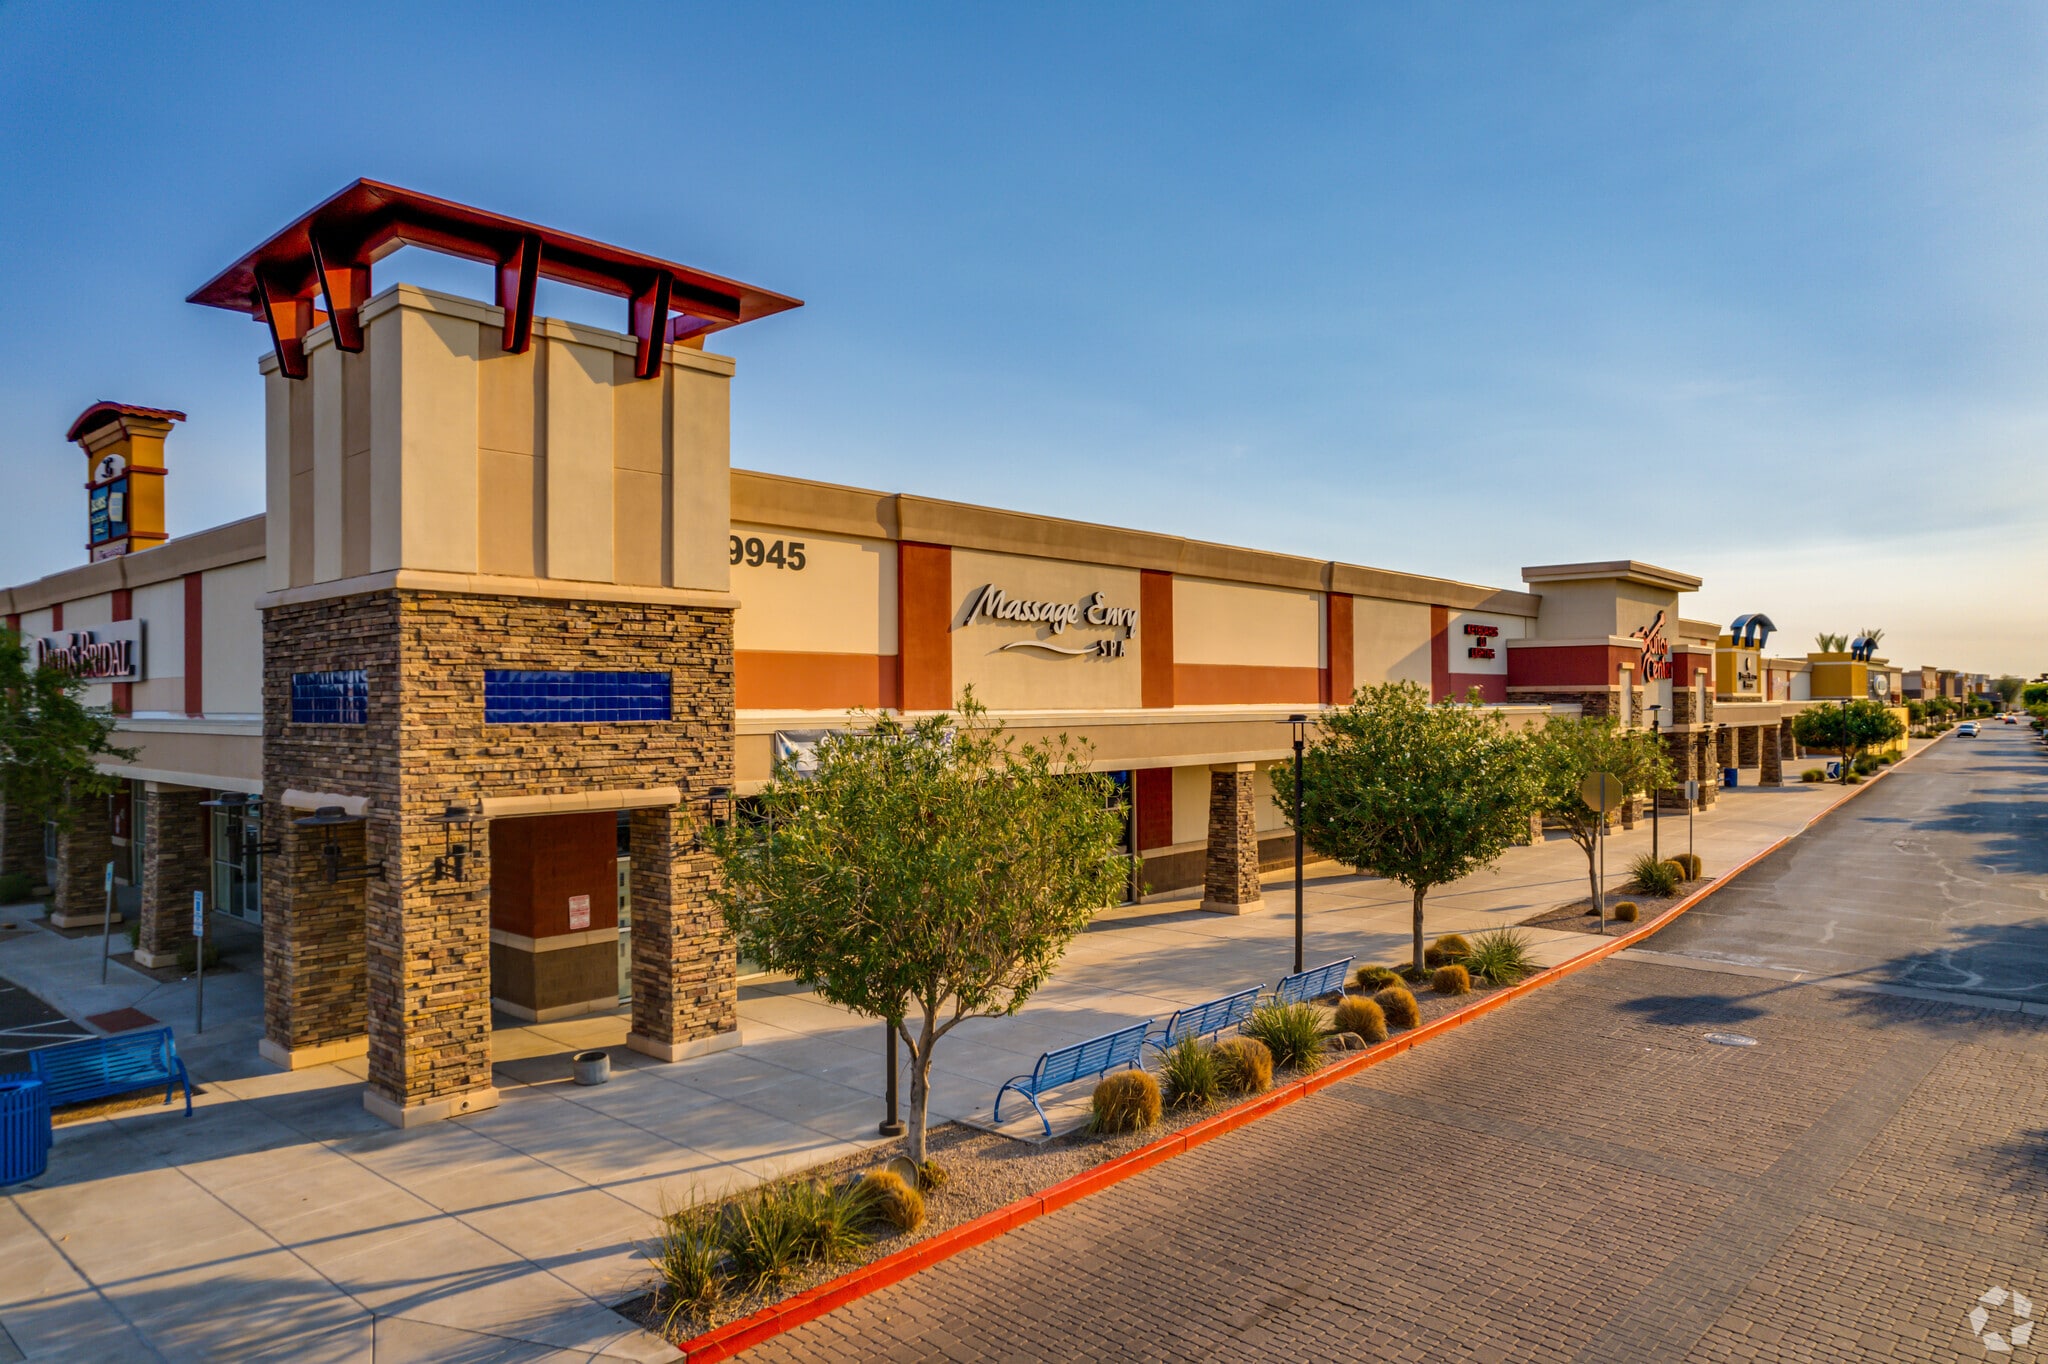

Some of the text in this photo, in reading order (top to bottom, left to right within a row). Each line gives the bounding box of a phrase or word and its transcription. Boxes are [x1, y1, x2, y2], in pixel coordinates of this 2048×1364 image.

[730, 534, 806, 571] 9945
[964, 583, 1138, 639] Massage Envy
[1098, 640, 1126, 657] SPA
